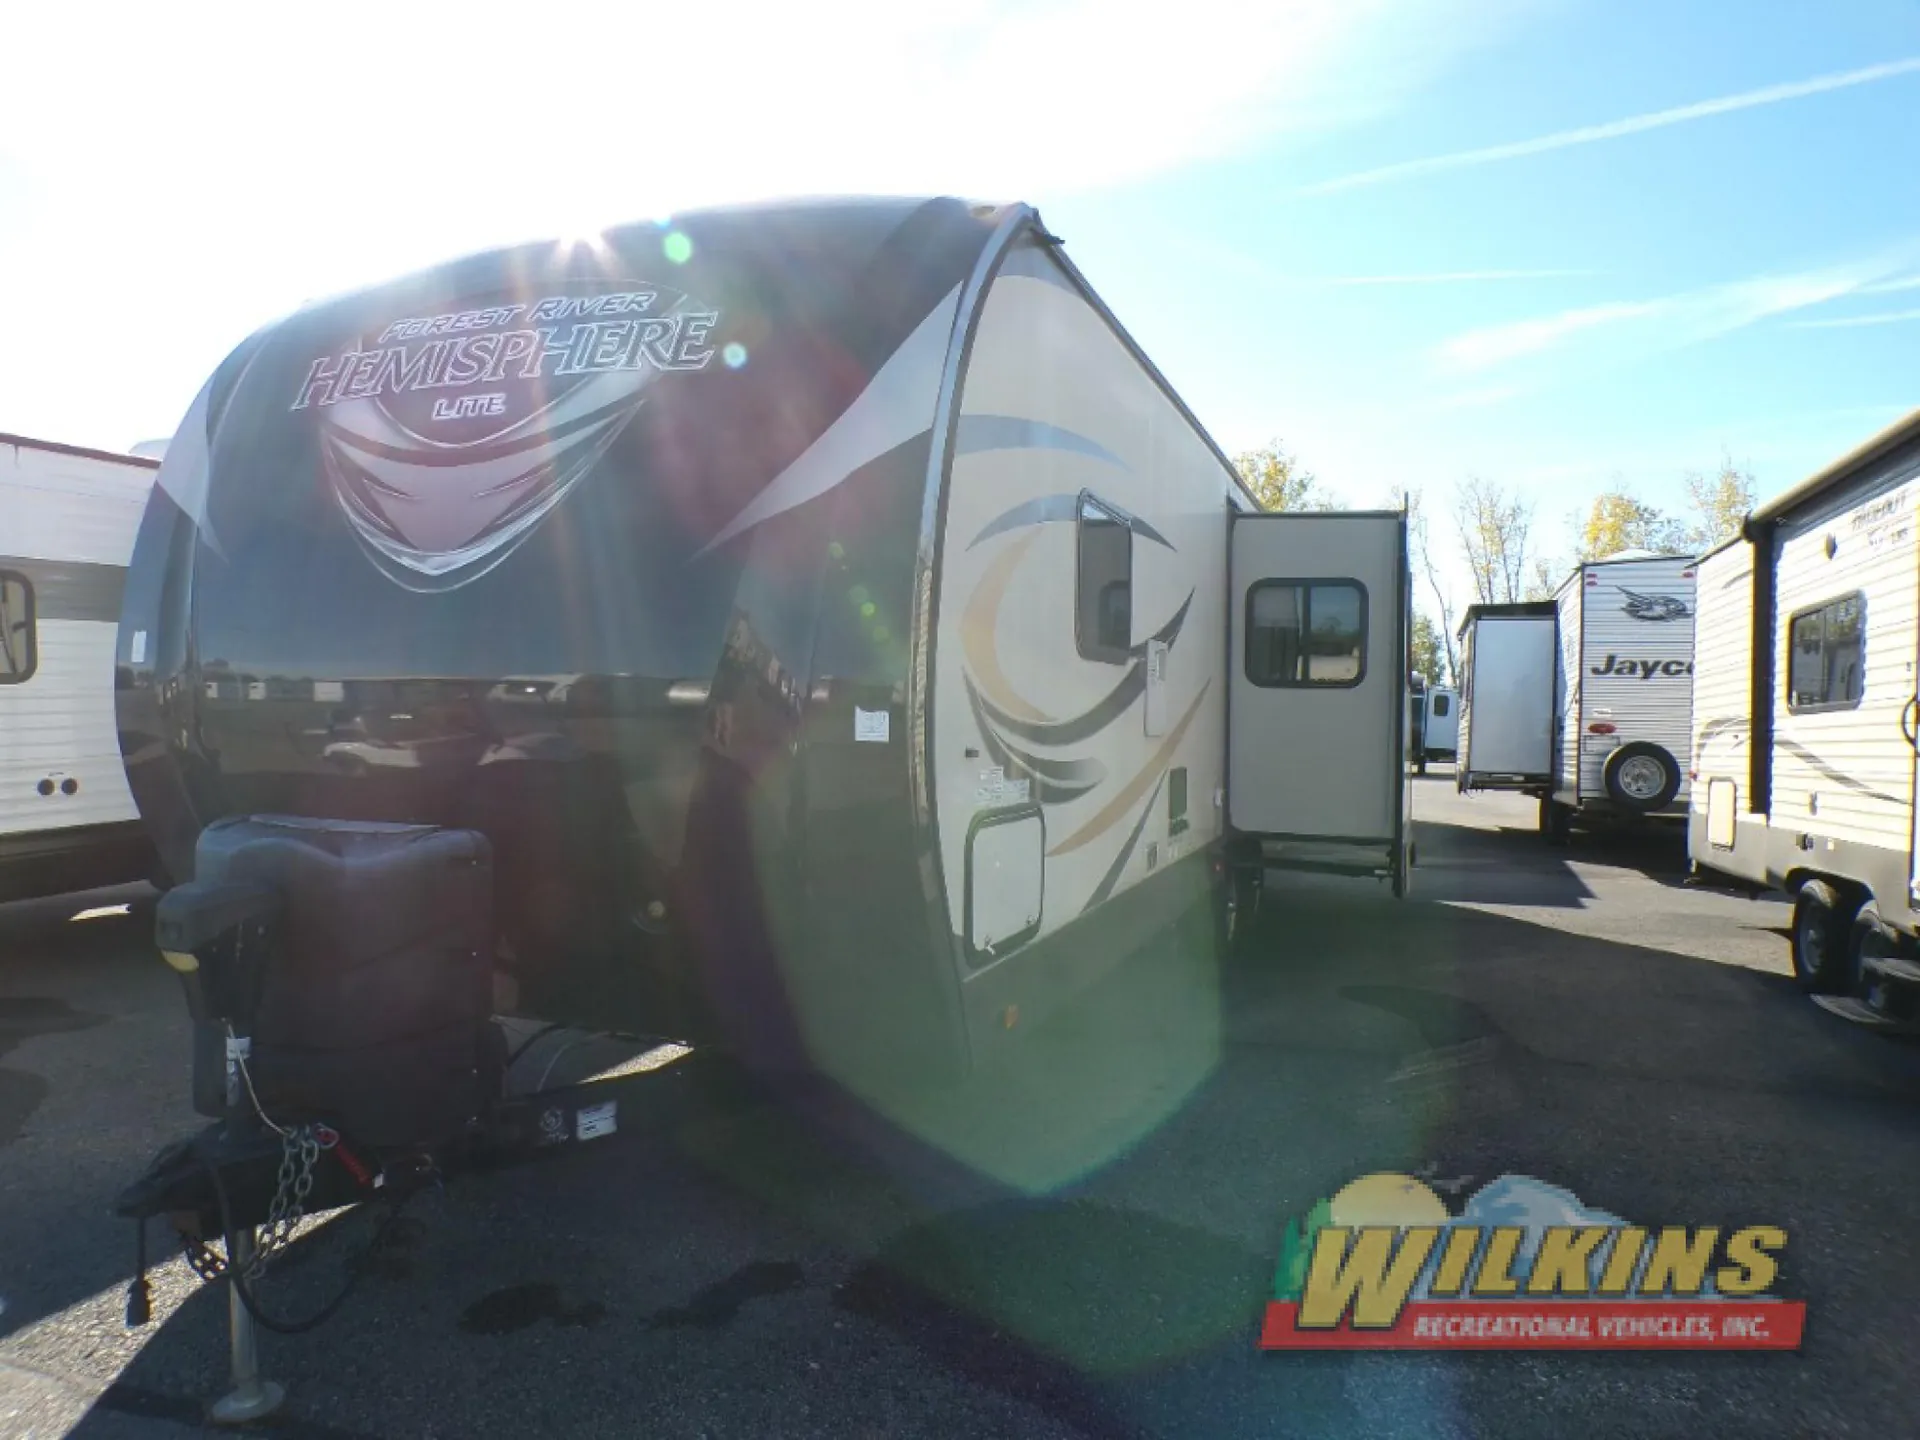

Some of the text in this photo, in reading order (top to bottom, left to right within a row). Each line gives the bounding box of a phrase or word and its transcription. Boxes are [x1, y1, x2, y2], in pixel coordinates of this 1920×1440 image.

[379, 292, 657, 343] FOREST RIVER
[290, 311, 718, 411] HEMISPHERE
[432, 393, 506, 420] LITE
